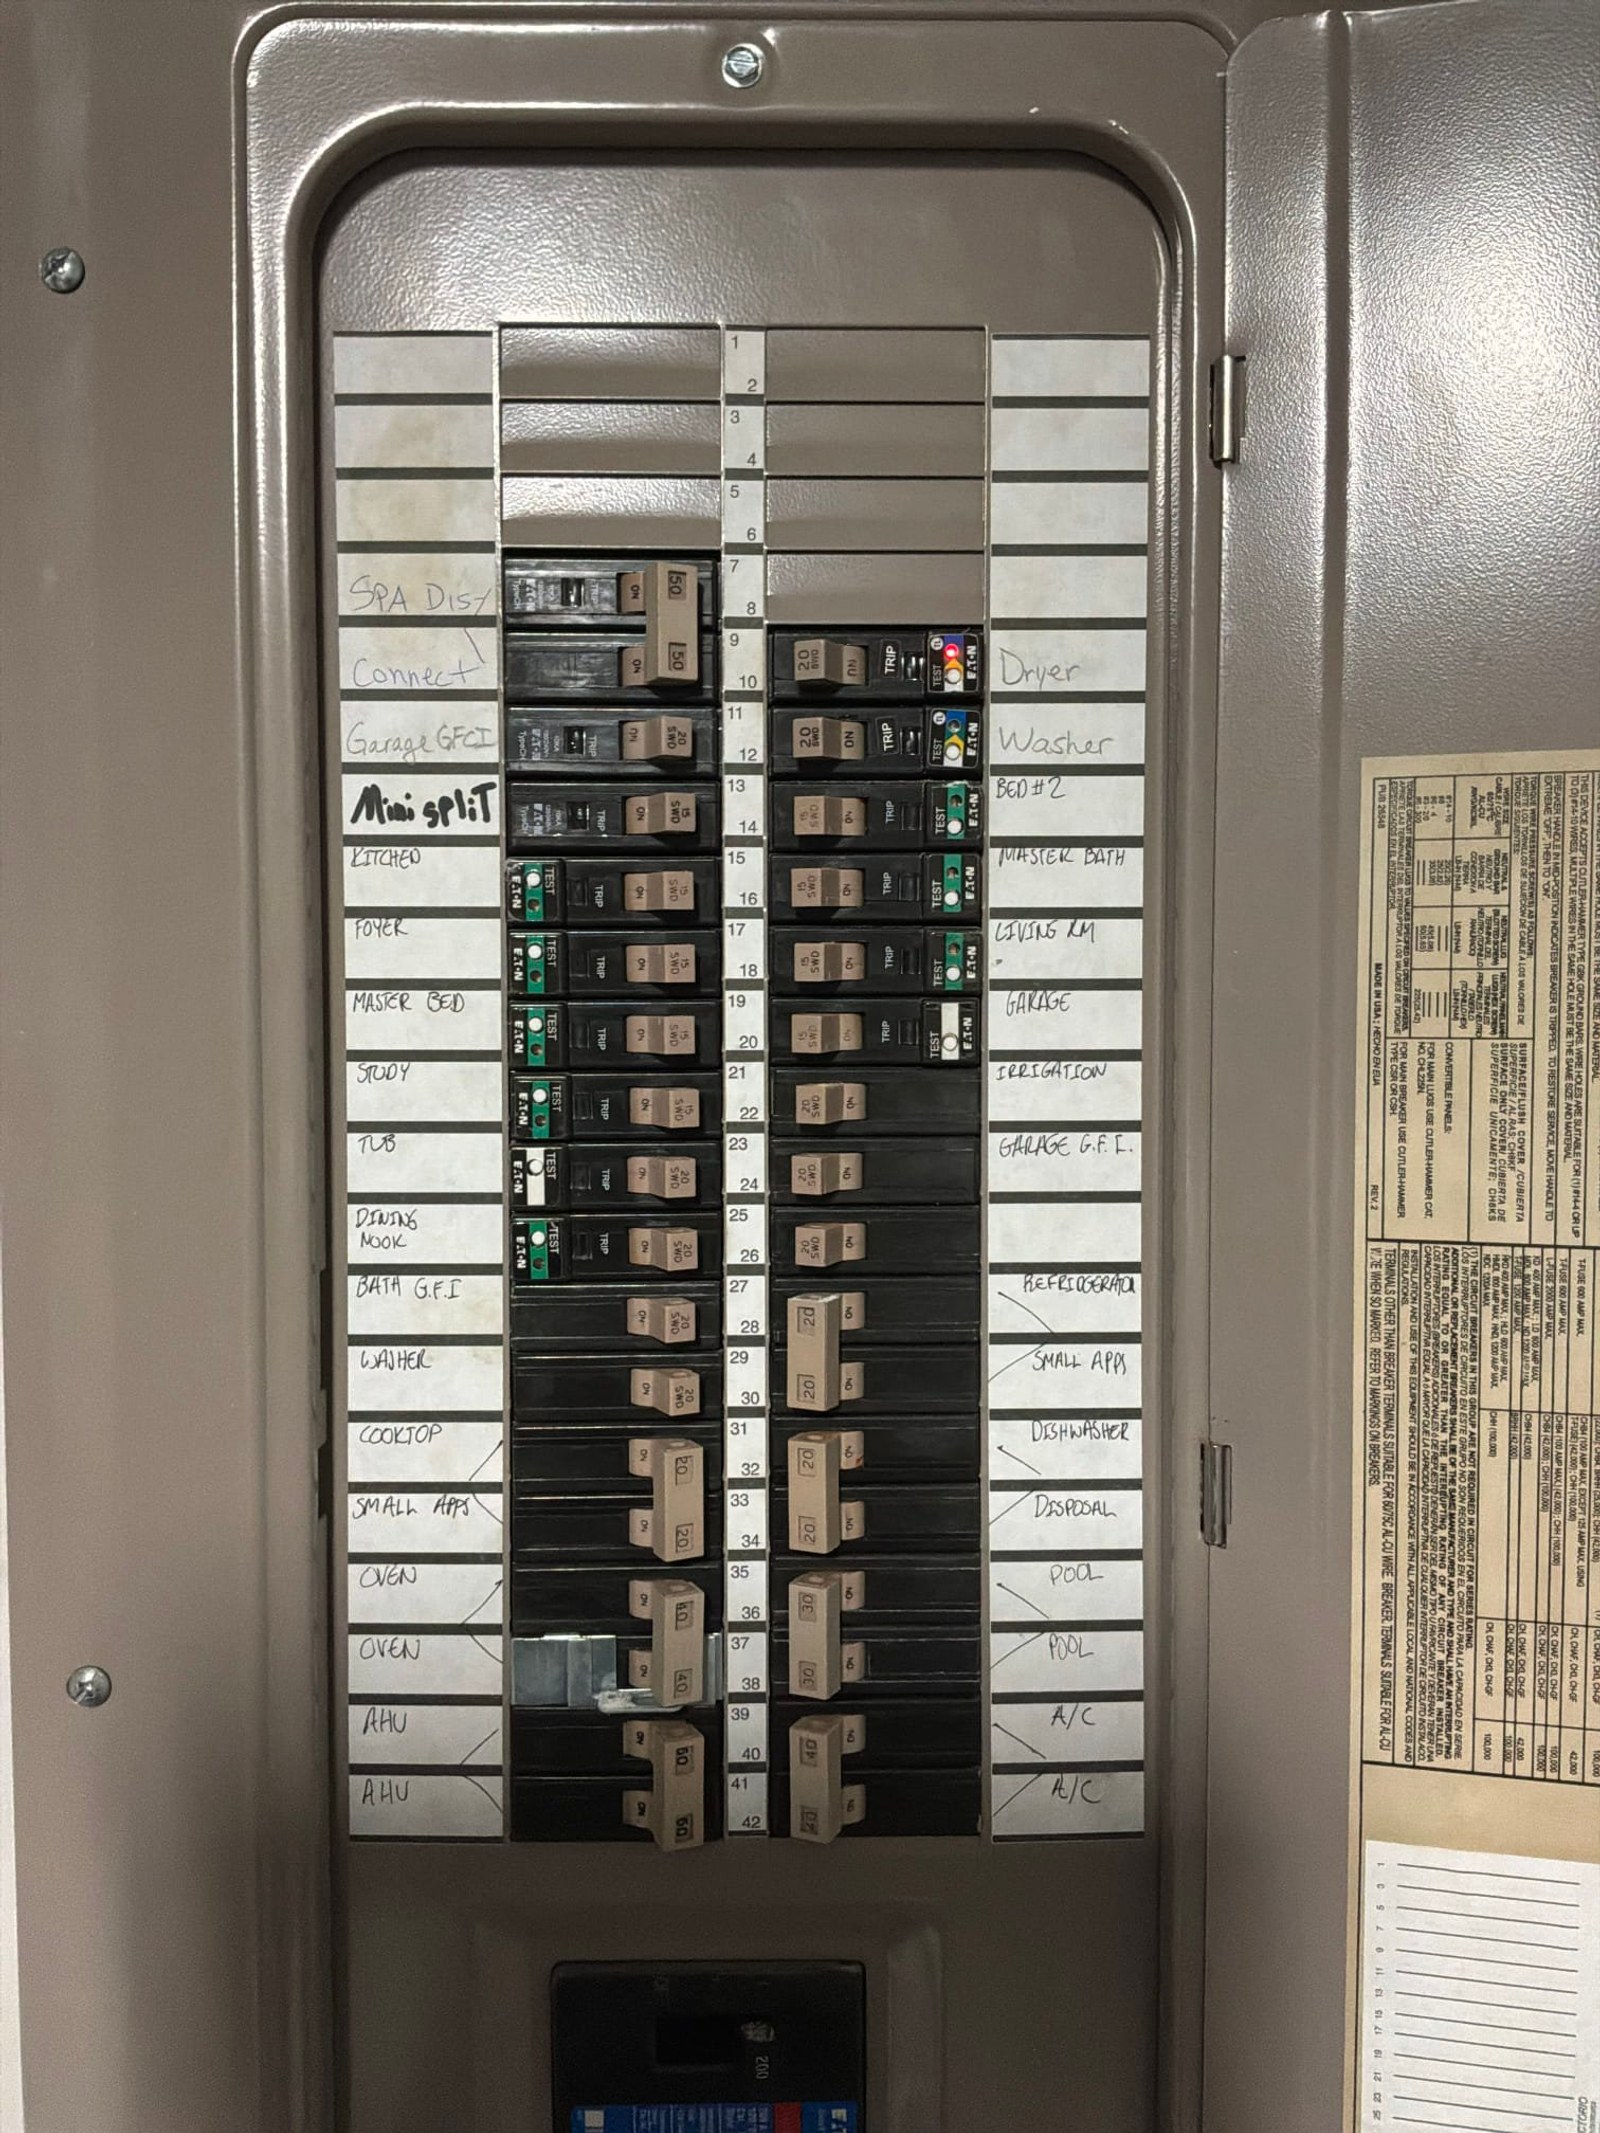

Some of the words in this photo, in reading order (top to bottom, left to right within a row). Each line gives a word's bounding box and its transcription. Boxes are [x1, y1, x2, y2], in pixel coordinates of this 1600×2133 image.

[732, 336, 737, 349] 1
[748, 379, 757, 392] 2
[731, 410, 739, 423] 3
[747, 453, 756, 466] 4
[731, 485, 739, 498] 5
[747, 528, 756, 540] 6
[730, 559, 739, 572] 7
[350, 575, 407, 612] SPA
[631, 585, 639, 599] ON
[669, 576, 682, 598] 50
[747, 602, 755, 615] 8
[730, 634, 739, 646] 9
[672, 652, 684, 670] 50
[885, 646, 896, 674] TRIP
[999, 647, 1081, 690] Dryer
[353, 658, 479, 687] Connect
[740, 675, 757, 688] 10
[933, 665, 941, 686] TEST
[728, 707, 741, 719] 11
[346, 721, 434, 766] Garage
[589, 736, 597, 756] TRIP
[668, 727, 676, 749] SWD
[678, 731, 686, 745] 20
[800, 727, 811, 747] 20
[882, 723, 893, 751] TRIP
[999, 727, 1113, 754] Washer
[740, 748, 757, 761] 12
[933, 739, 942, 760] TEST
[729, 779, 745, 792] 13
[996, 778, 1027, 798] BED
[636, 807, 645, 820] ON
[671, 801, 680, 823] SWD
[886, 801, 894, 823] TRIP
[936, 807, 945, 833] TEST
[740, 821, 758, 833] 14
[728, 851, 745, 864] 15
[998, 849, 1073, 864] MASTER
[1084, 849, 1125, 865] BATH
[545, 867, 554, 894] TEST
[595, 886, 603, 907] TRIP
[740, 892, 757, 905] 16
[355, 918, 408, 938] FOYER
[729, 923, 745, 936] 17
[995, 921, 1056, 942] LIVING
[547, 940, 556, 966] TEST
[597, 957, 605, 978] TRIP
[740, 964, 757, 977] 18
[933, 960, 942, 986] TEST
[1374, 963, 1382, 988] MADE
[353, 992, 412, 1012] MASTER
[427, 993, 464, 1012] BED
[729, 995, 745, 1007] 19
[1005, 992, 1071, 1013] GARAGE
[1374, 990, 1382, 999] IN
[598, 1028, 606, 1050] TRIP
[740, 1036, 758, 1048] 20
[1373, 1026, 1381, 1055] HECHO
[357, 1063, 410, 1083] STUDY
[729, 1066, 745, 1079] 21
[997, 1063, 1107, 1080] IRRIGATION
[1426, 1062, 1434, 1082] MAIN
[1444, 1042, 1453, 1098] CONVERTIBLE
[1500, 1043, 1508, 1086] SURFACE
[552, 1085, 561, 1112] TEST
[1426, 1084, 1434, 1108] LUGS
[601, 1099, 609, 1120] TRIP
[740, 1107, 758, 1119] 22
[1425, 1109, 1433, 1126] USE
[358, 1135, 396, 1152] TUB
[729, 1138, 747, 1150] 23
[999, 1135, 1071, 1157] GARAGE
[1517, 1130, 1525, 1164] COVER
[741, 1178, 758, 1191] 24
[356, 1208, 417, 1230] DINING
[730, 1209, 748, 1221] 25
[361, 1232, 407, 1249] NOOK
[549, 1227, 559, 1253] TEST
[600, 1233, 608, 1254] TRIP
[741, 1249, 759, 1262] 26
[1384, 1249, 1396, 1294] TERMINALS
[356, 1278, 401, 1294] BATH
[730, 1280, 748, 1292] 27
[1384, 1297, 1395, 1325] OTHER
[741, 1320, 759, 1333] 28
[1384, 1327, 1394, 1349] THAN
[361, 1349, 431, 1371] WASHER
[730, 1351, 748, 1364] 29
[1033, 1351, 1081, 1371] SMALL
[1091, 1351, 1126, 1375] APPS
[1370, 1348, 1381, 1374] REFER
[1383, 1351, 1394, 1390] BREAKER
[1370, 1376, 1380, 1387] TO
[742, 1392, 759, 1404] 30
[1369, 1388, 1380, 1428] MARKINGS
[1383, 1392, 1394, 1439] TERMINALS
[360, 1425, 442, 1445] COOKTOP
[731, 1423, 746, 1435] 31
[1031, 1422, 1128, 1441] DISHWASHER
[1369, 1430, 1380, 1442] ON
[678, 1456, 688, 1476] 20
[803, 1448, 814, 1469] 20
[1382, 1441, 1394, 1479] SUITABLE
[742, 1463, 759, 1476] 32
[1382, 1481, 1393, 1498] FOR
[353, 1496, 417, 1519] SMALL
[434, 1495, 469, 1516] APPS
[731, 1494, 749, 1506] 33
[1035, 1494, 1116, 1517] DISPOSAL
[742, 1534, 759, 1547] 34
[360, 1566, 417, 1588] OVEN
[731, 1566, 749, 1578] 35
[1051, 1563, 1104, 1585] POOL
[742, 1606, 760, 1619] 36
[802, 1593, 813, 1613] 30
[360, 1637, 420, 1660] OVEN
[732, 1637, 749, 1649] 37
[1049, 1637, 1094, 1658] POOL
[742, 1678, 760, 1690] 38
[363, 1707, 407, 1735] AHU
[731, 1708, 749, 1720] 39
[1051, 1705, 1095, 1726] A/C
[742, 1748, 760, 1760] 40
[362, 1779, 408, 1806] AHU
[731, 1778, 747, 1789] 41
[742, 1816, 760, 1828] 42
[756, 2056, 769, 2079] 200
